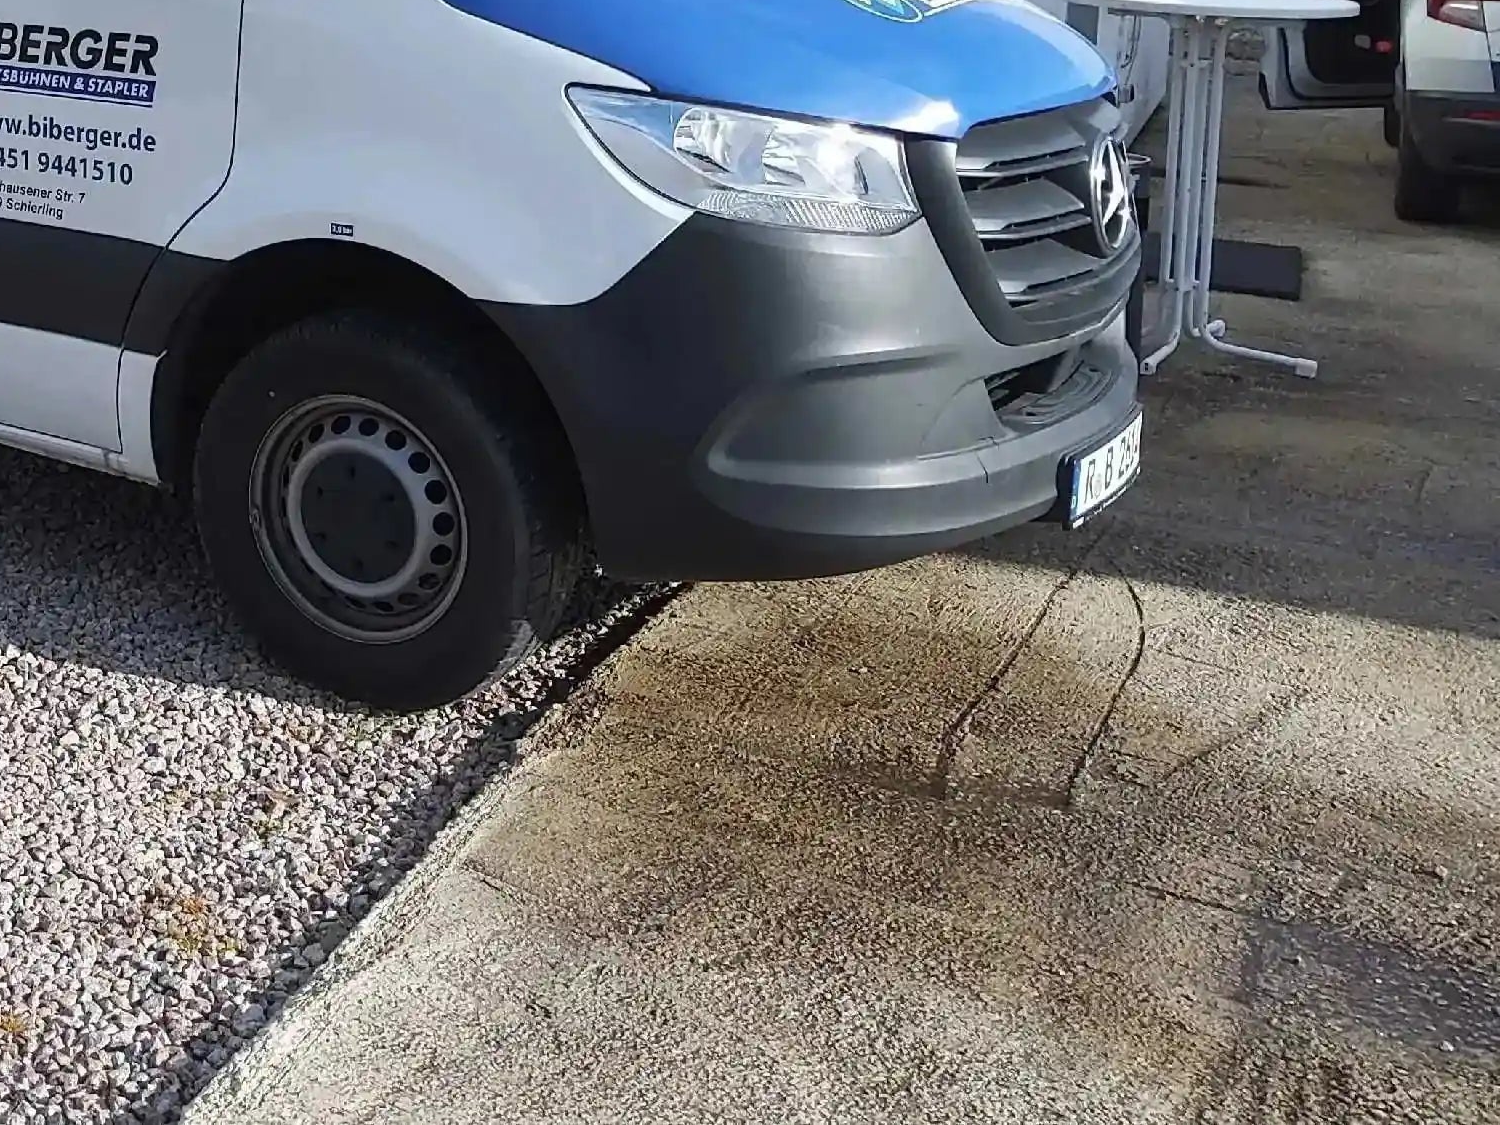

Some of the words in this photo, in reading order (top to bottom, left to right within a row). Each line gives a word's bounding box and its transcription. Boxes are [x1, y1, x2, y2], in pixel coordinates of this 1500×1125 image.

[74, 76, 85, 91] &
[87, 78, 149, 98] STAPLER
[37, 152, 133, 186] 9441510
[54, 188, 75, 204] Str.
[78, 192, 86, 204] 7
[6, 197, 64, 220] Schierling
[1084, 458, 1097, 505] R
[1104, 446, 1114, 490] B
